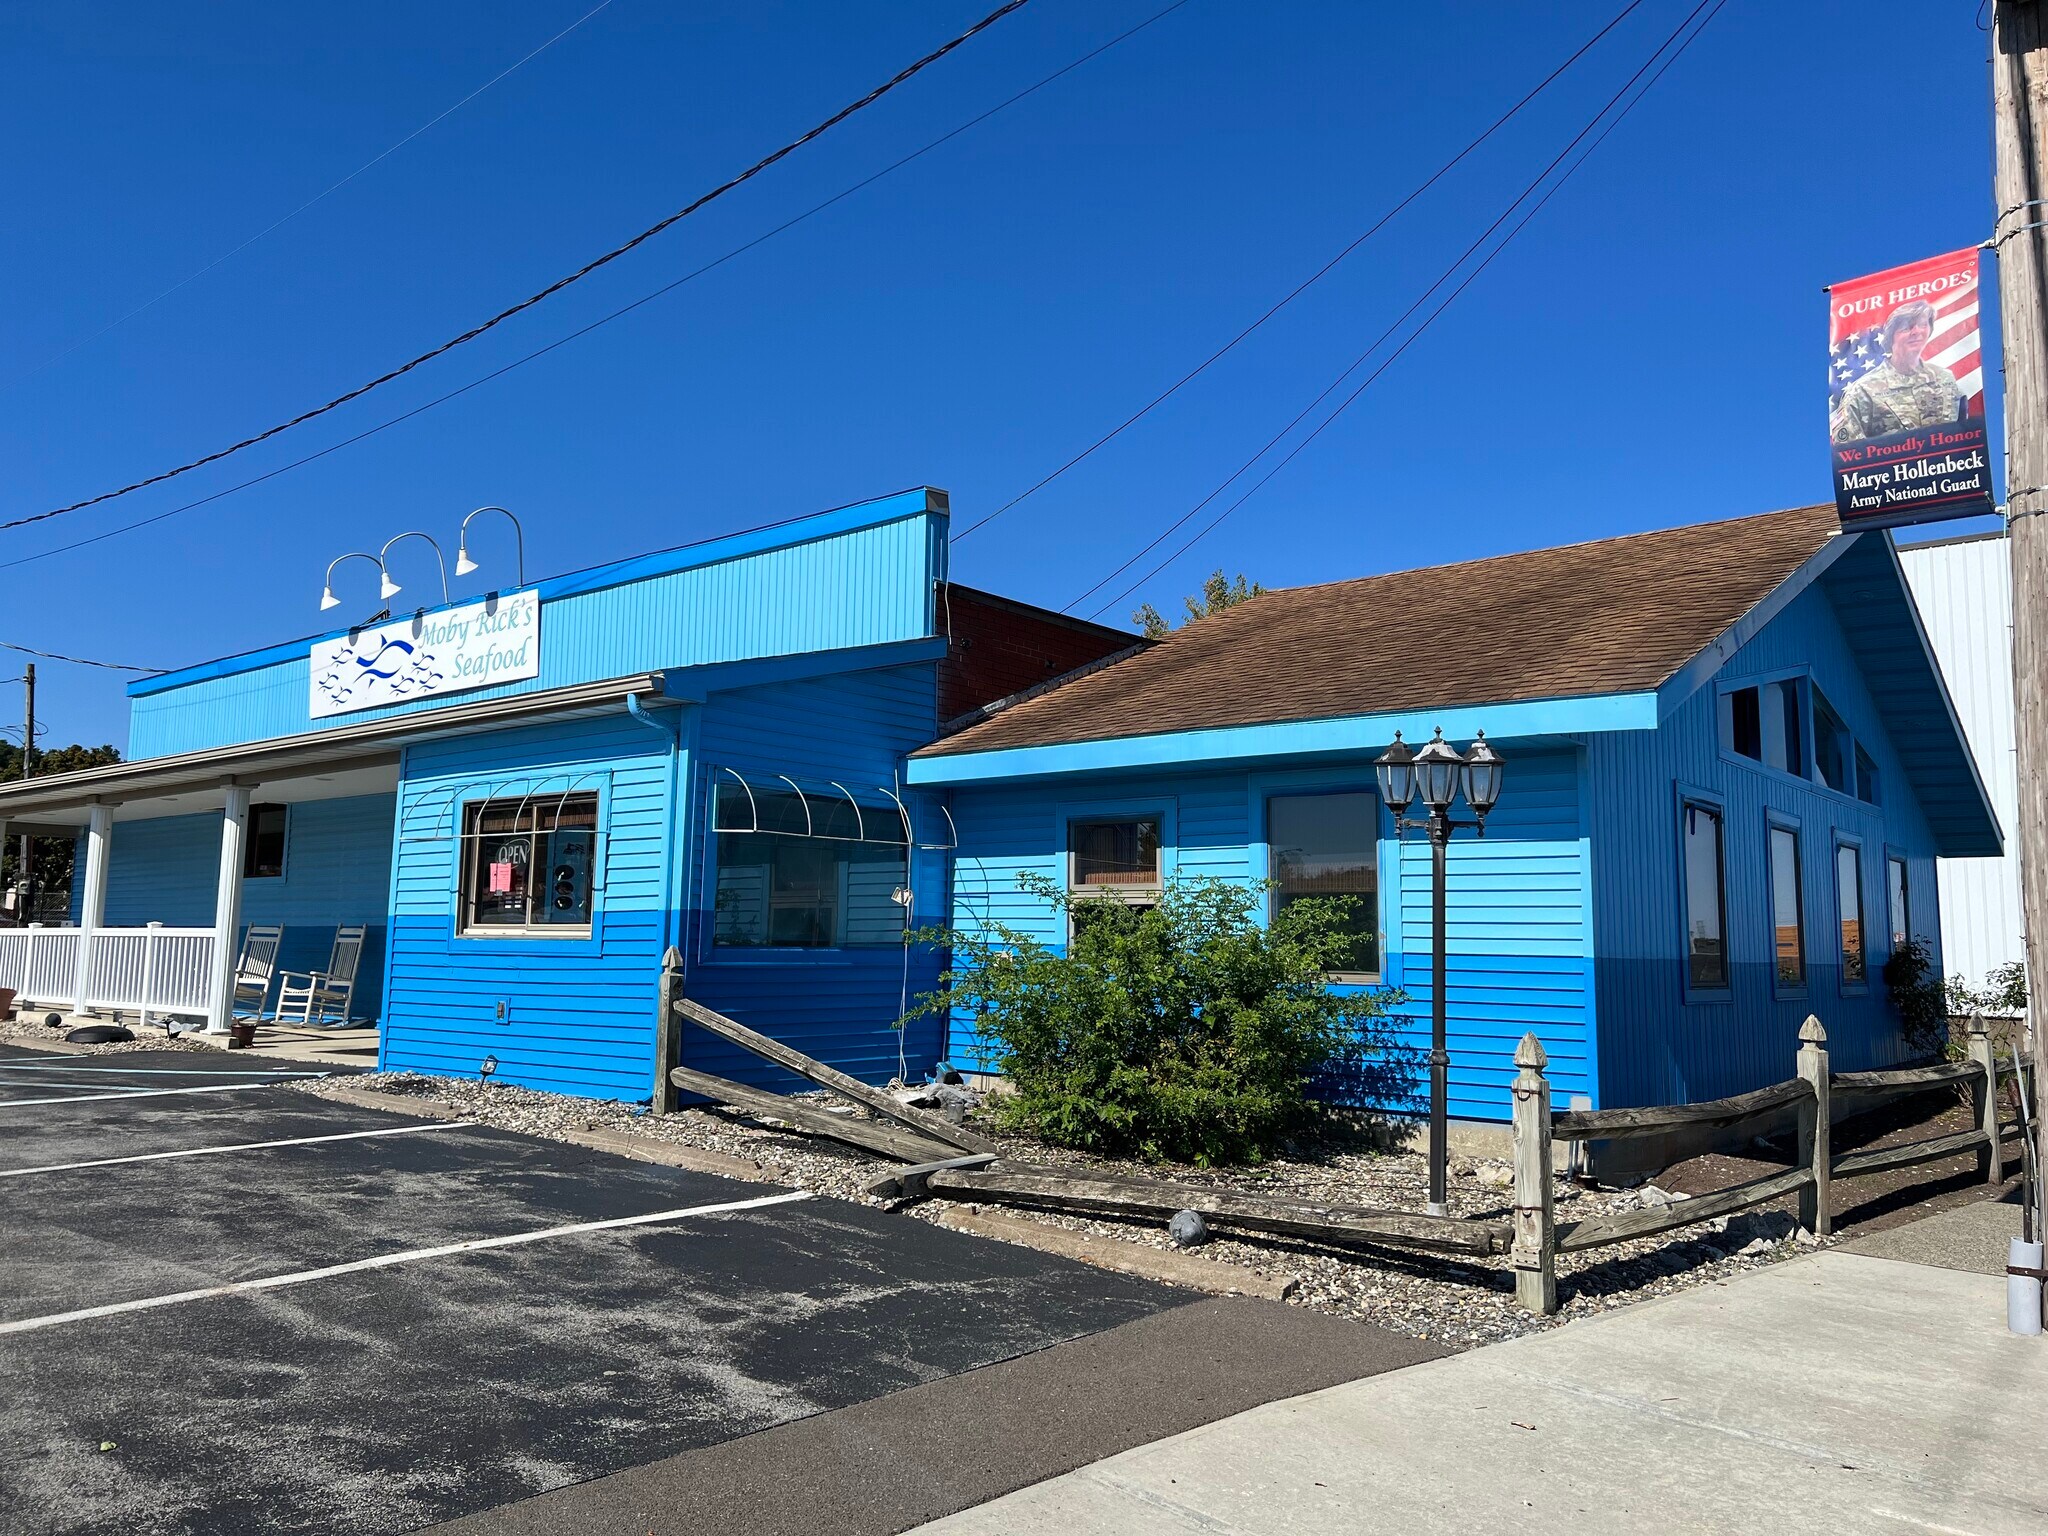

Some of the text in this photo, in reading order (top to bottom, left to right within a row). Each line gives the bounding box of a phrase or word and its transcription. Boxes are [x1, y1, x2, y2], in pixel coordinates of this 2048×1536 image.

[1838, 269, 1973, 319] OUR HEROES
[1839, 430, 1981, 463] We Proudly Honor
[1842, 450, 1985, 491] Marye Hollenbeck
[1850, 473, 1981, 508] Army National Guard
[418, 598, 533, 650] Moby Rick's
[451, 635, 533, 684] Seafood
[498, 845, 528, 864] OPEN
